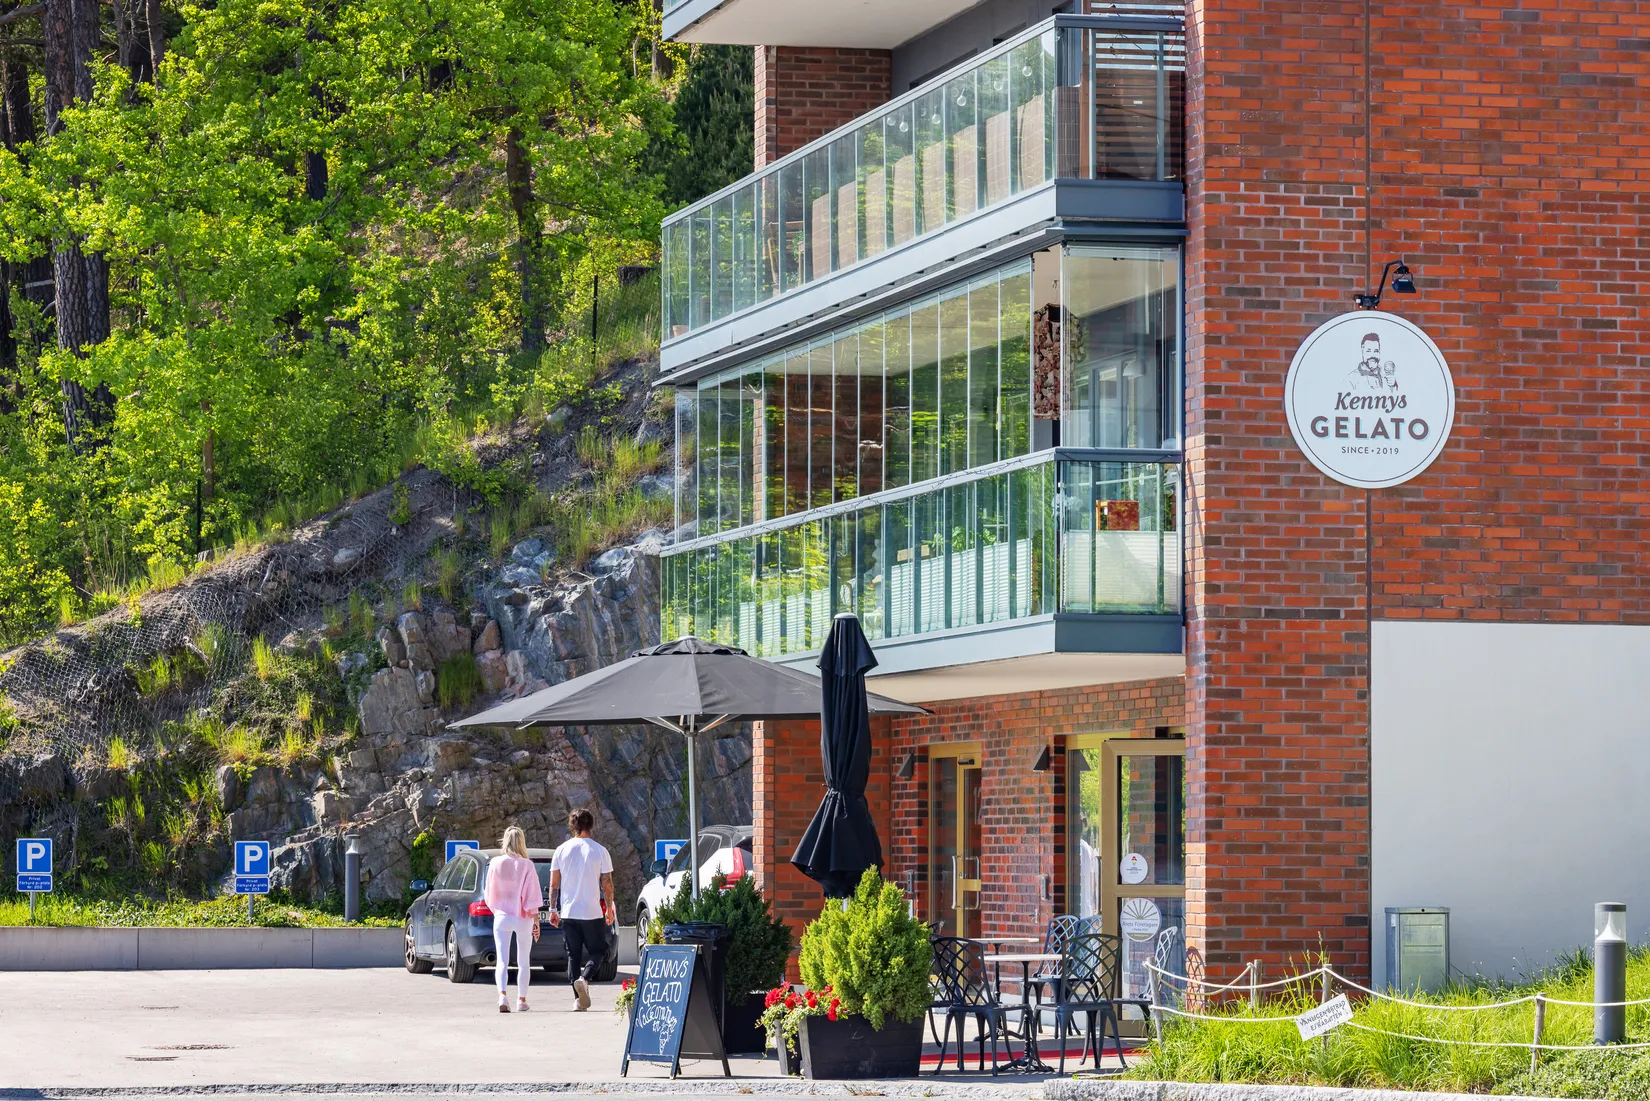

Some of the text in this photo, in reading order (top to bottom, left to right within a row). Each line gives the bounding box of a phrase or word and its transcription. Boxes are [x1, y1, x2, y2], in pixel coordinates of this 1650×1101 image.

[1334, 392, 1408, 413] Kennys
[1310, 416, 1430, 441] GELATO
[1341, 446, 1399, 455] SINCE 2019
[27, 843, 45, 869] P
[245, 845, 263, 872] P
[642, 981, 682, 1006] GELATO
